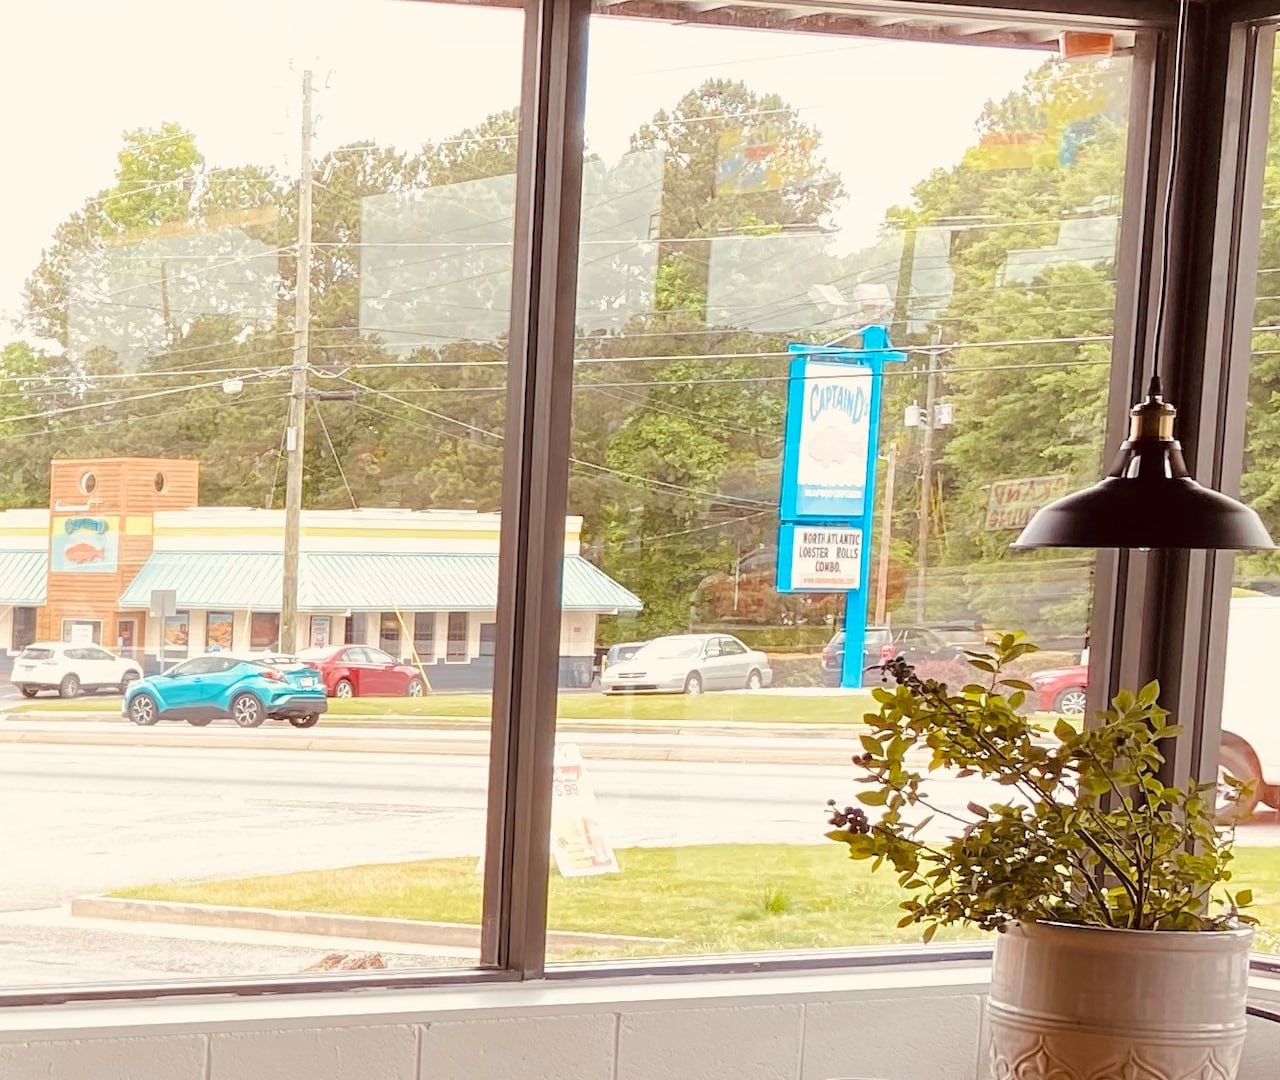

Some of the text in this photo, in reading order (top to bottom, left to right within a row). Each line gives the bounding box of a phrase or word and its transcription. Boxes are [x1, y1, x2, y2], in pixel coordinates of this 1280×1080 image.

[803, 533, 860, 545] NORTH ATLANTIC
[799, 547, 859, 559] LOBSTER ROLLS
